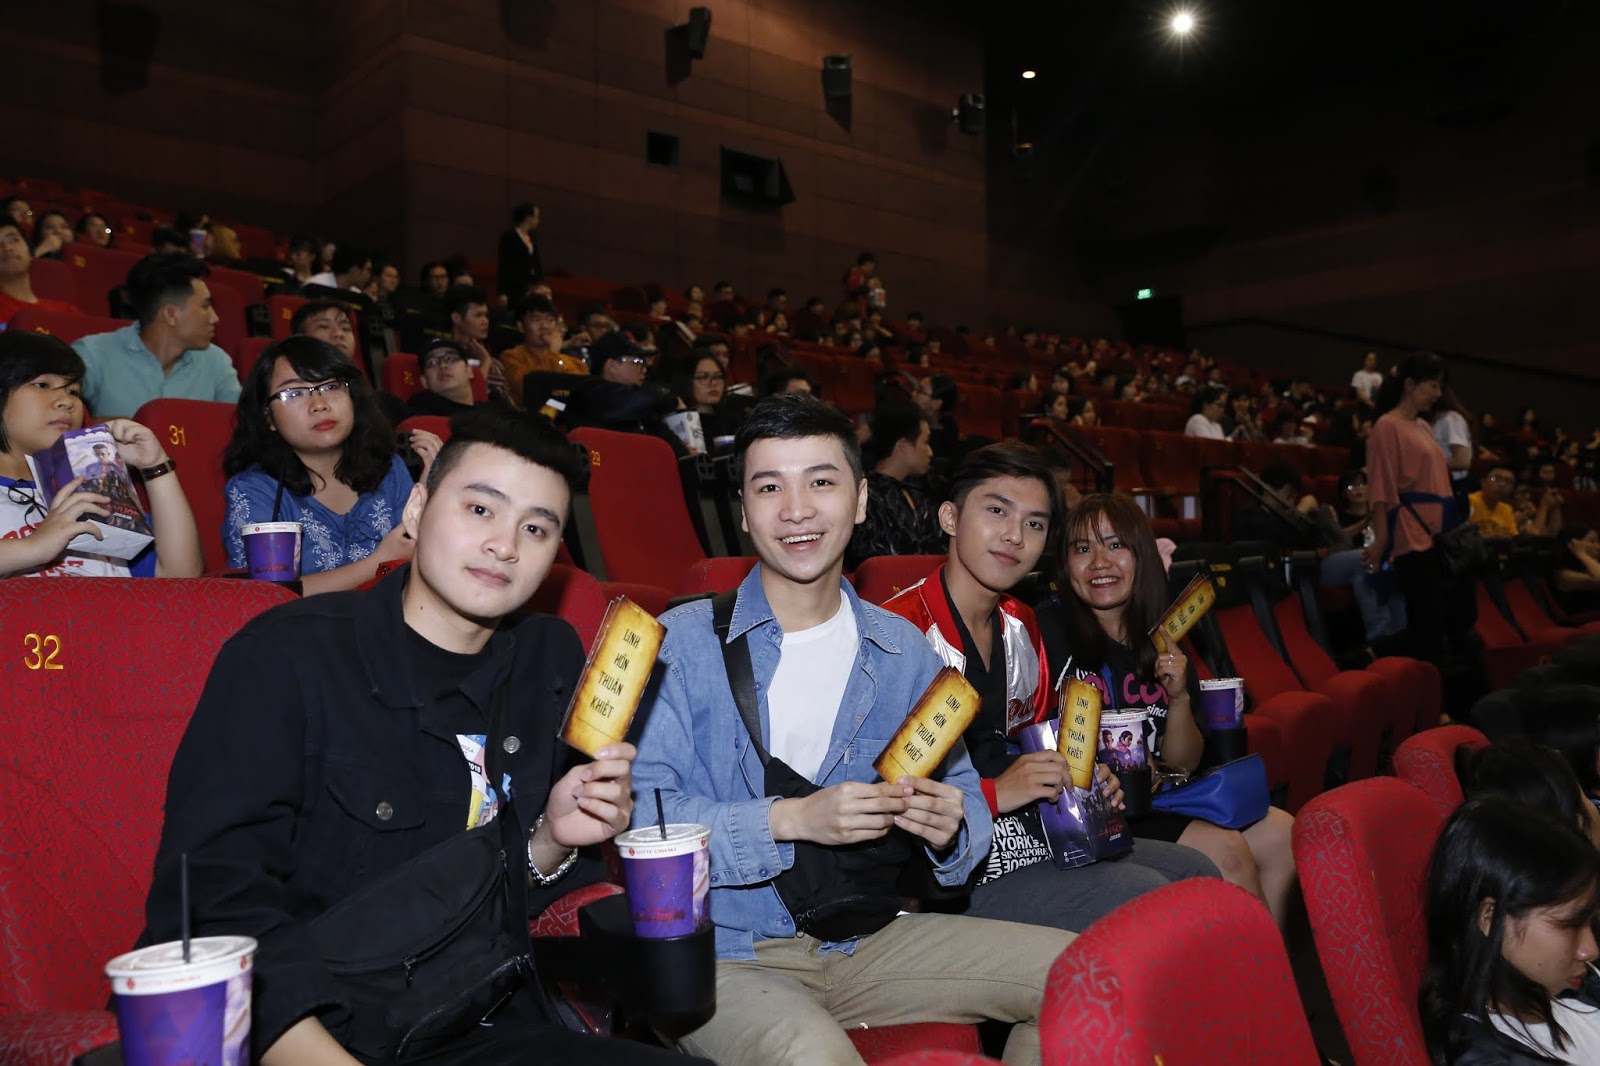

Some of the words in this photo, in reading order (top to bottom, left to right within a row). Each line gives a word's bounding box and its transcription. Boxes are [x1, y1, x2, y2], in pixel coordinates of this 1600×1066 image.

[169, 425, 187, 446] 31
[623, 628, 641, 649] LINH
[23, 633, 64, 671] 32
[945, 694, 961, 713] LINH
[1076, 696, 1089, 710] LINH
[1147, 704, 1168, 718] since
[993, 821, 1027, 838] NEW
[996, 834, 1033, 851] YORK
[1000, 847, 1049, 860] SINGAPORE
